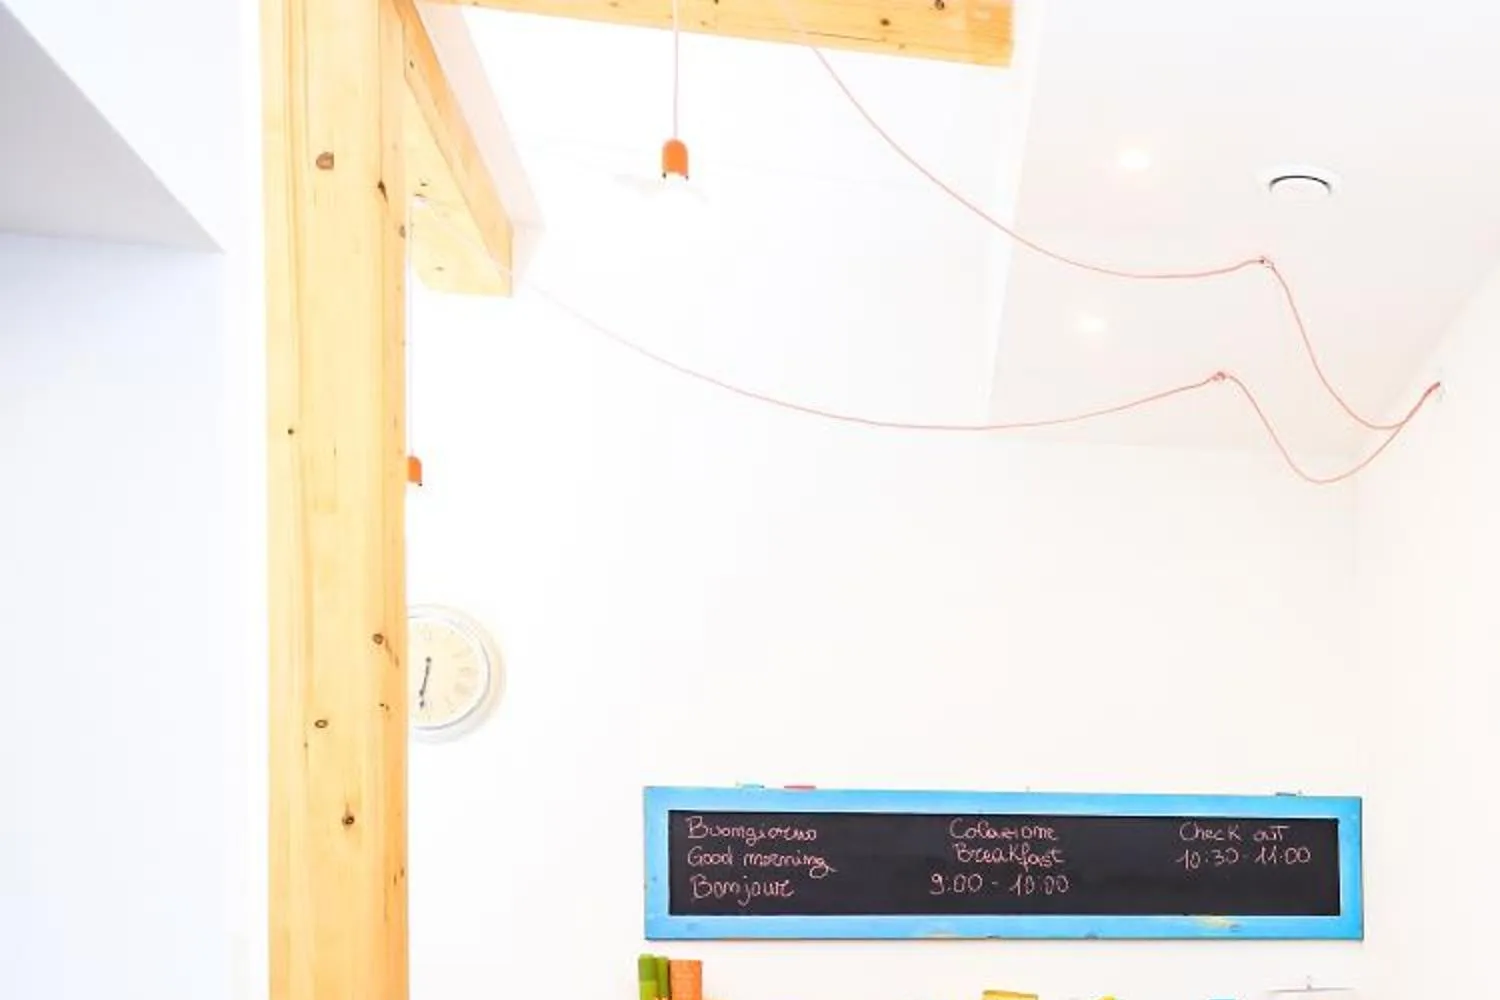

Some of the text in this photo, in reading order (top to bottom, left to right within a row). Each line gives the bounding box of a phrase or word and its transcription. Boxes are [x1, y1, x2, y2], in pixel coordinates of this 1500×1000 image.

[685, 815, 818, 847] Buongiorno
[687, 845, 838, 879] Good morning
[951, 841, 1065, 873] Breakfast
[689, 873, 796, 907] Bonjour
